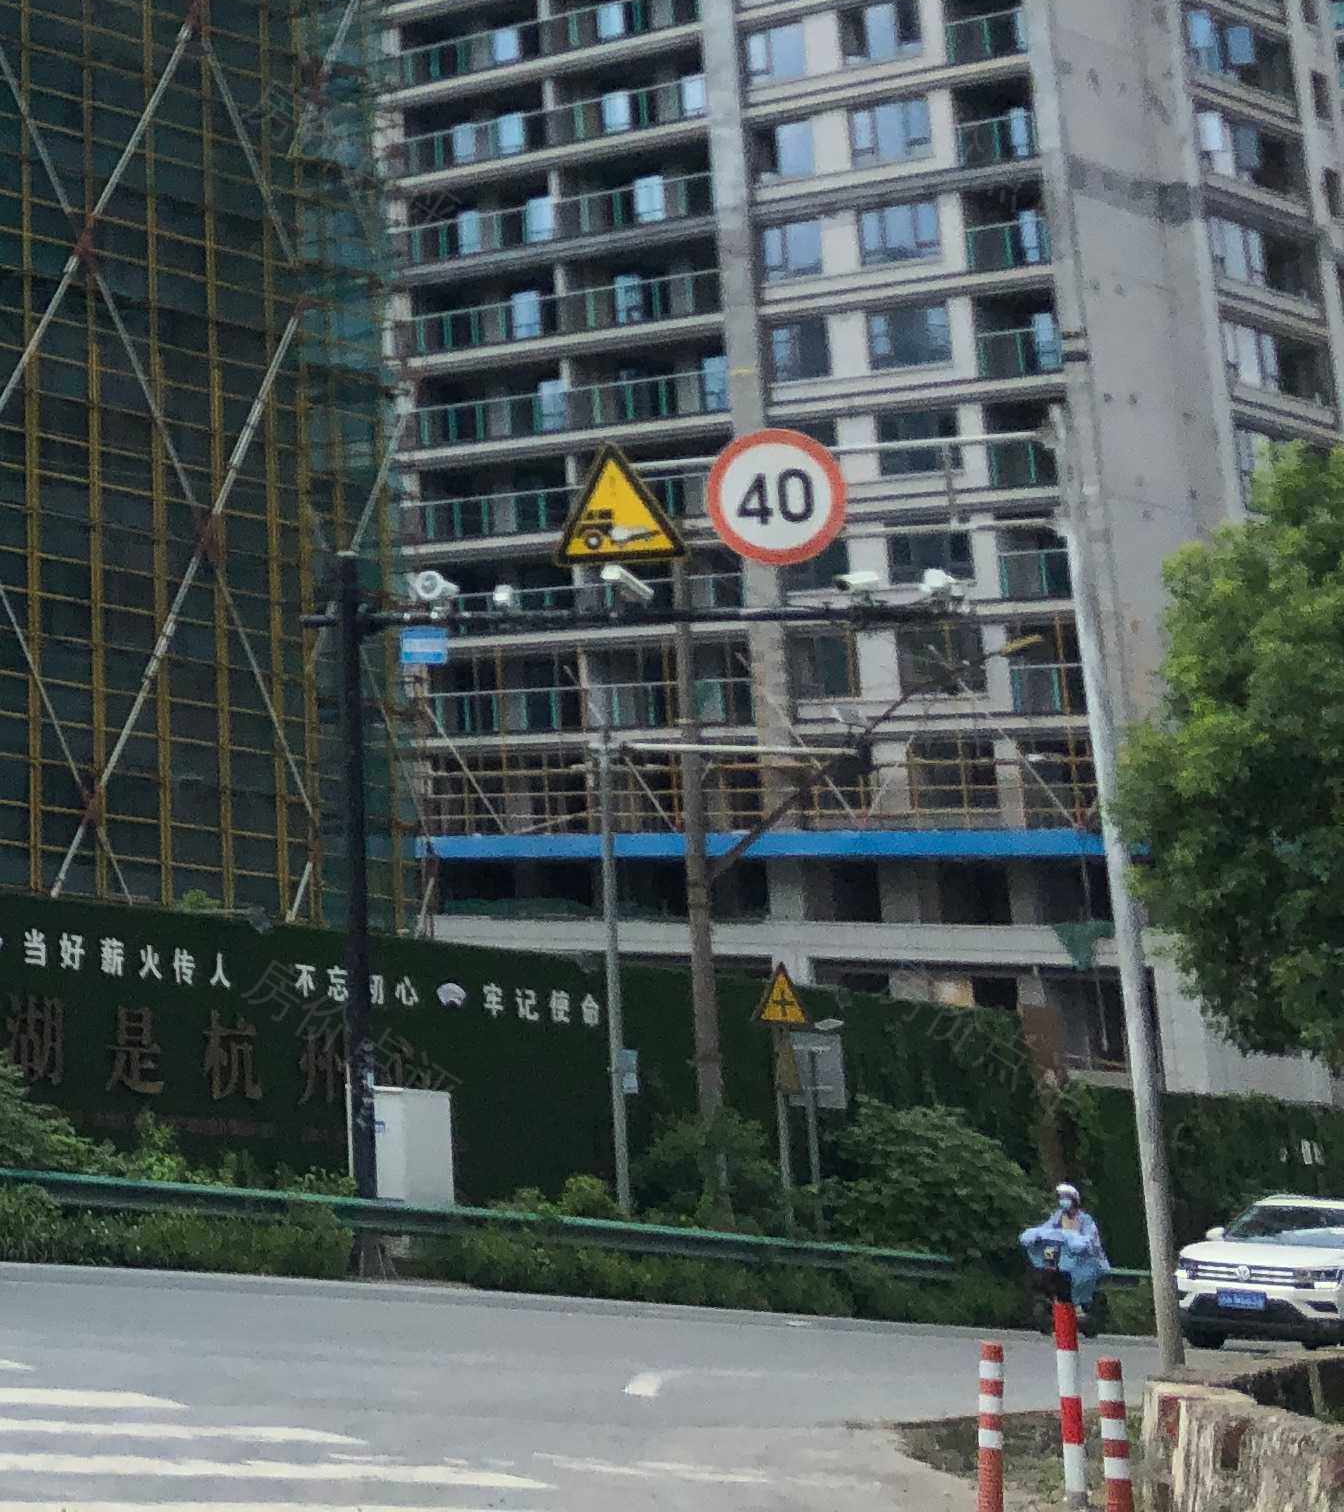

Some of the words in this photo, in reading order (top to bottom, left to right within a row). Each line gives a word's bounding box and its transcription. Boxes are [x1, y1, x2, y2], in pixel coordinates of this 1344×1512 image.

[737, 466, 816, 527] 40
[23, 926, 232, 991] 当好薪火传人
[481, 981, 601, 1028] 牢记使命
